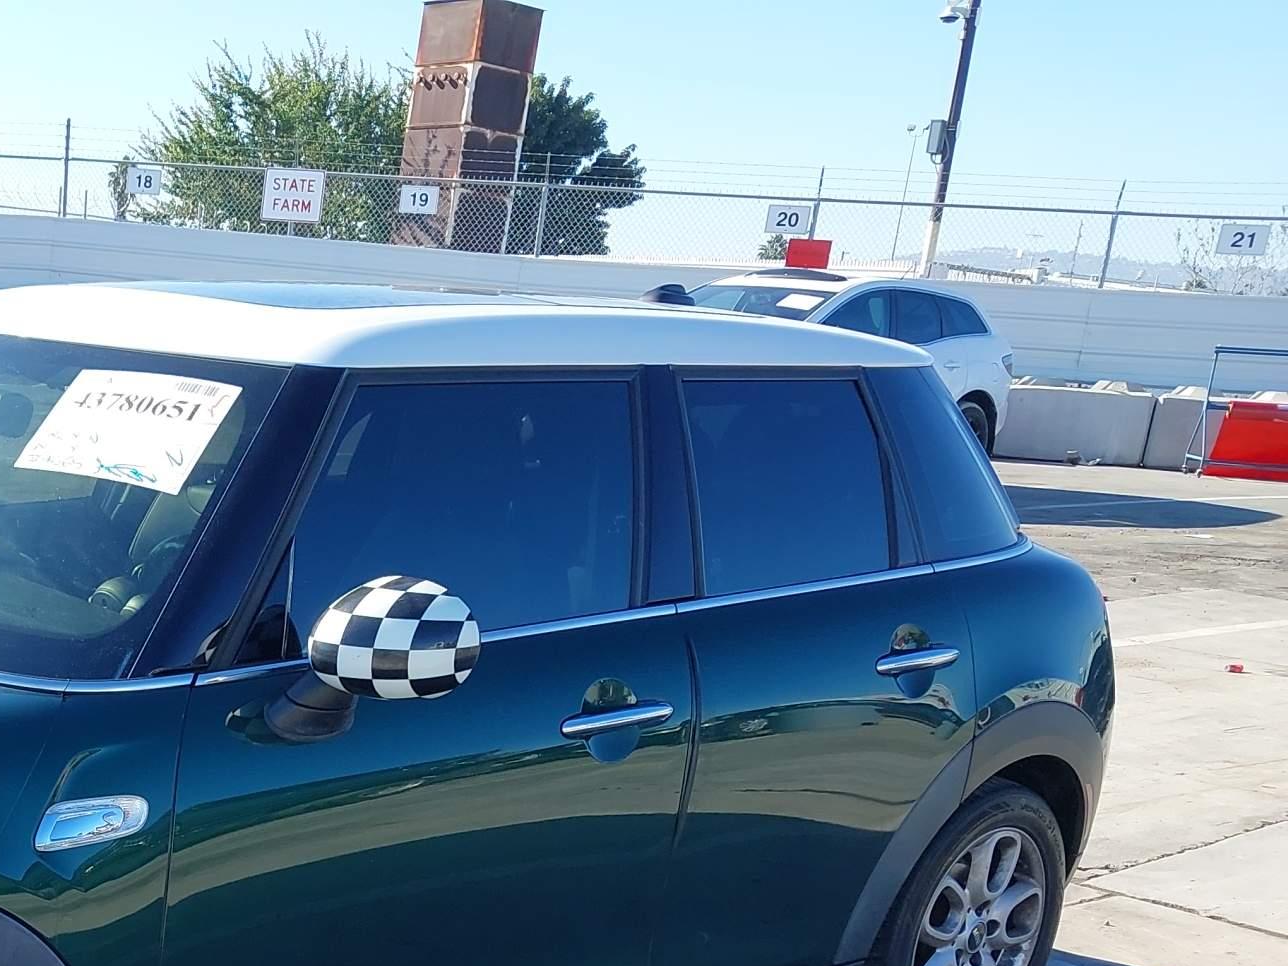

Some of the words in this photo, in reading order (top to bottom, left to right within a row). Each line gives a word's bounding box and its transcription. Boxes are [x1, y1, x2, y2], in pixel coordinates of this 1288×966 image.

[135, 174, 153, 189] 18
[272, 177, 317, 193] STATE
[272, 198, 312, 213] FARM
[410, 192, 430, 208] 19
[775, 211, 800, 228] 20
[1230, 231, 1257, 249] 21
[73, 390, 203, 422] 43780651
